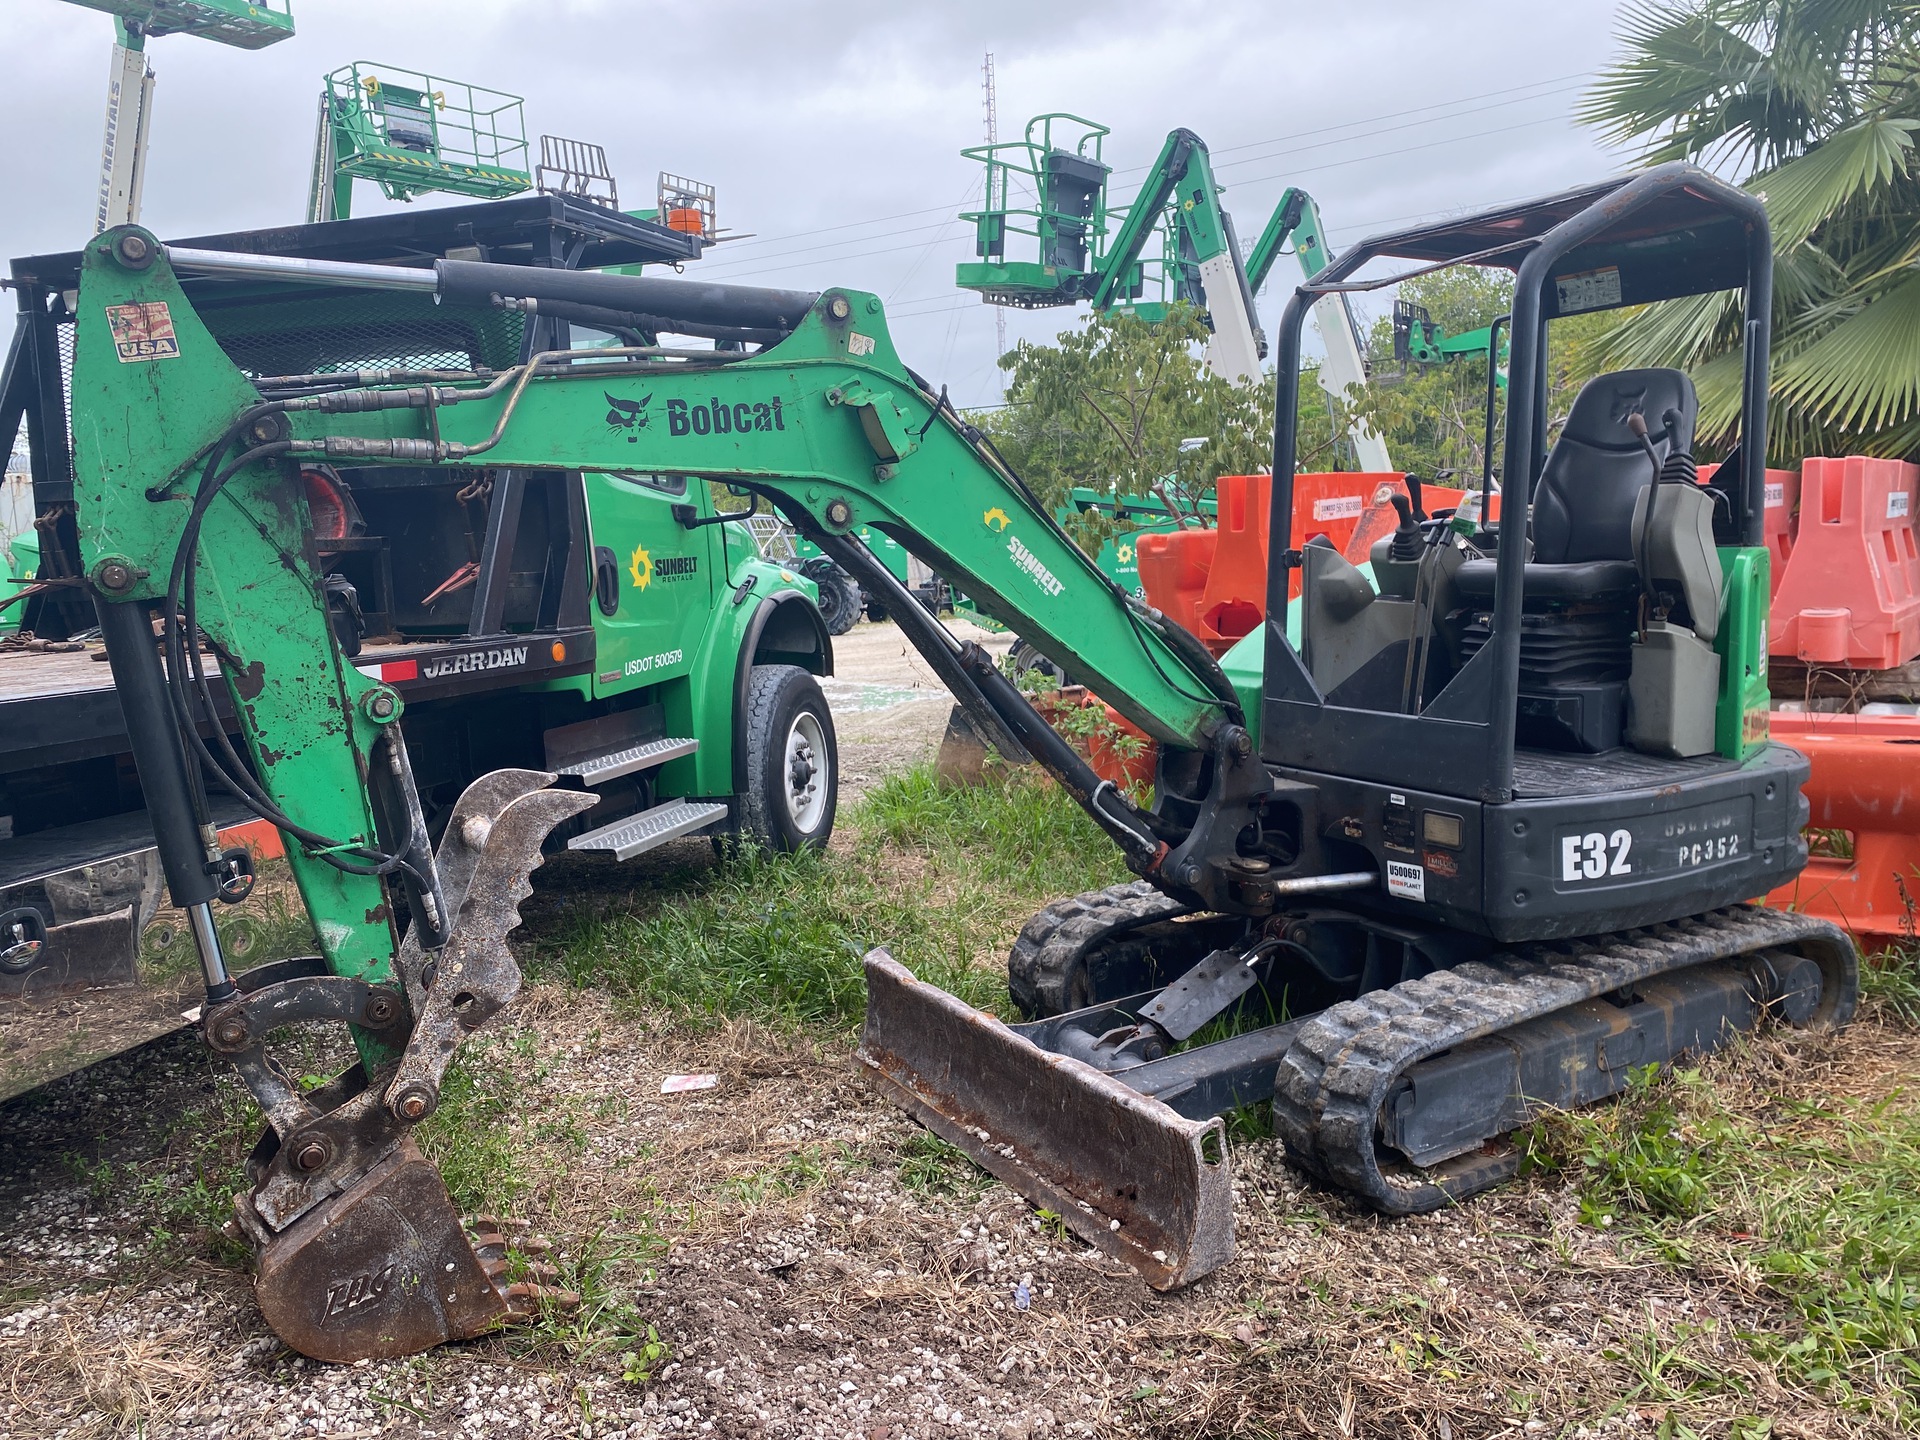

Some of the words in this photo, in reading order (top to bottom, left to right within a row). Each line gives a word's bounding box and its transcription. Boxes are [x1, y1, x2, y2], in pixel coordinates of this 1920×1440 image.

[103, 81, 120, 172] RENTALS
[97, 175, 111, 235] NBELT
[121, 340, 174, 356] USA
[667, 397, 785, 436] Bobcat
[654, 556, 698, 577] SUNBELT
[662, 574, 694, 583] RENTALS
[1006, 535, 1066, 597] SUNBELT
[1009, 554, 1049, 596] RENALS
[624, 655, 654, 676] USDOT
[654, 648, 683, 668] 500579
[1562, 829, 1632, 882] E32
[1678, 834, 1739, 867] PC352
[1389, 864, 1421, 880] U500697
